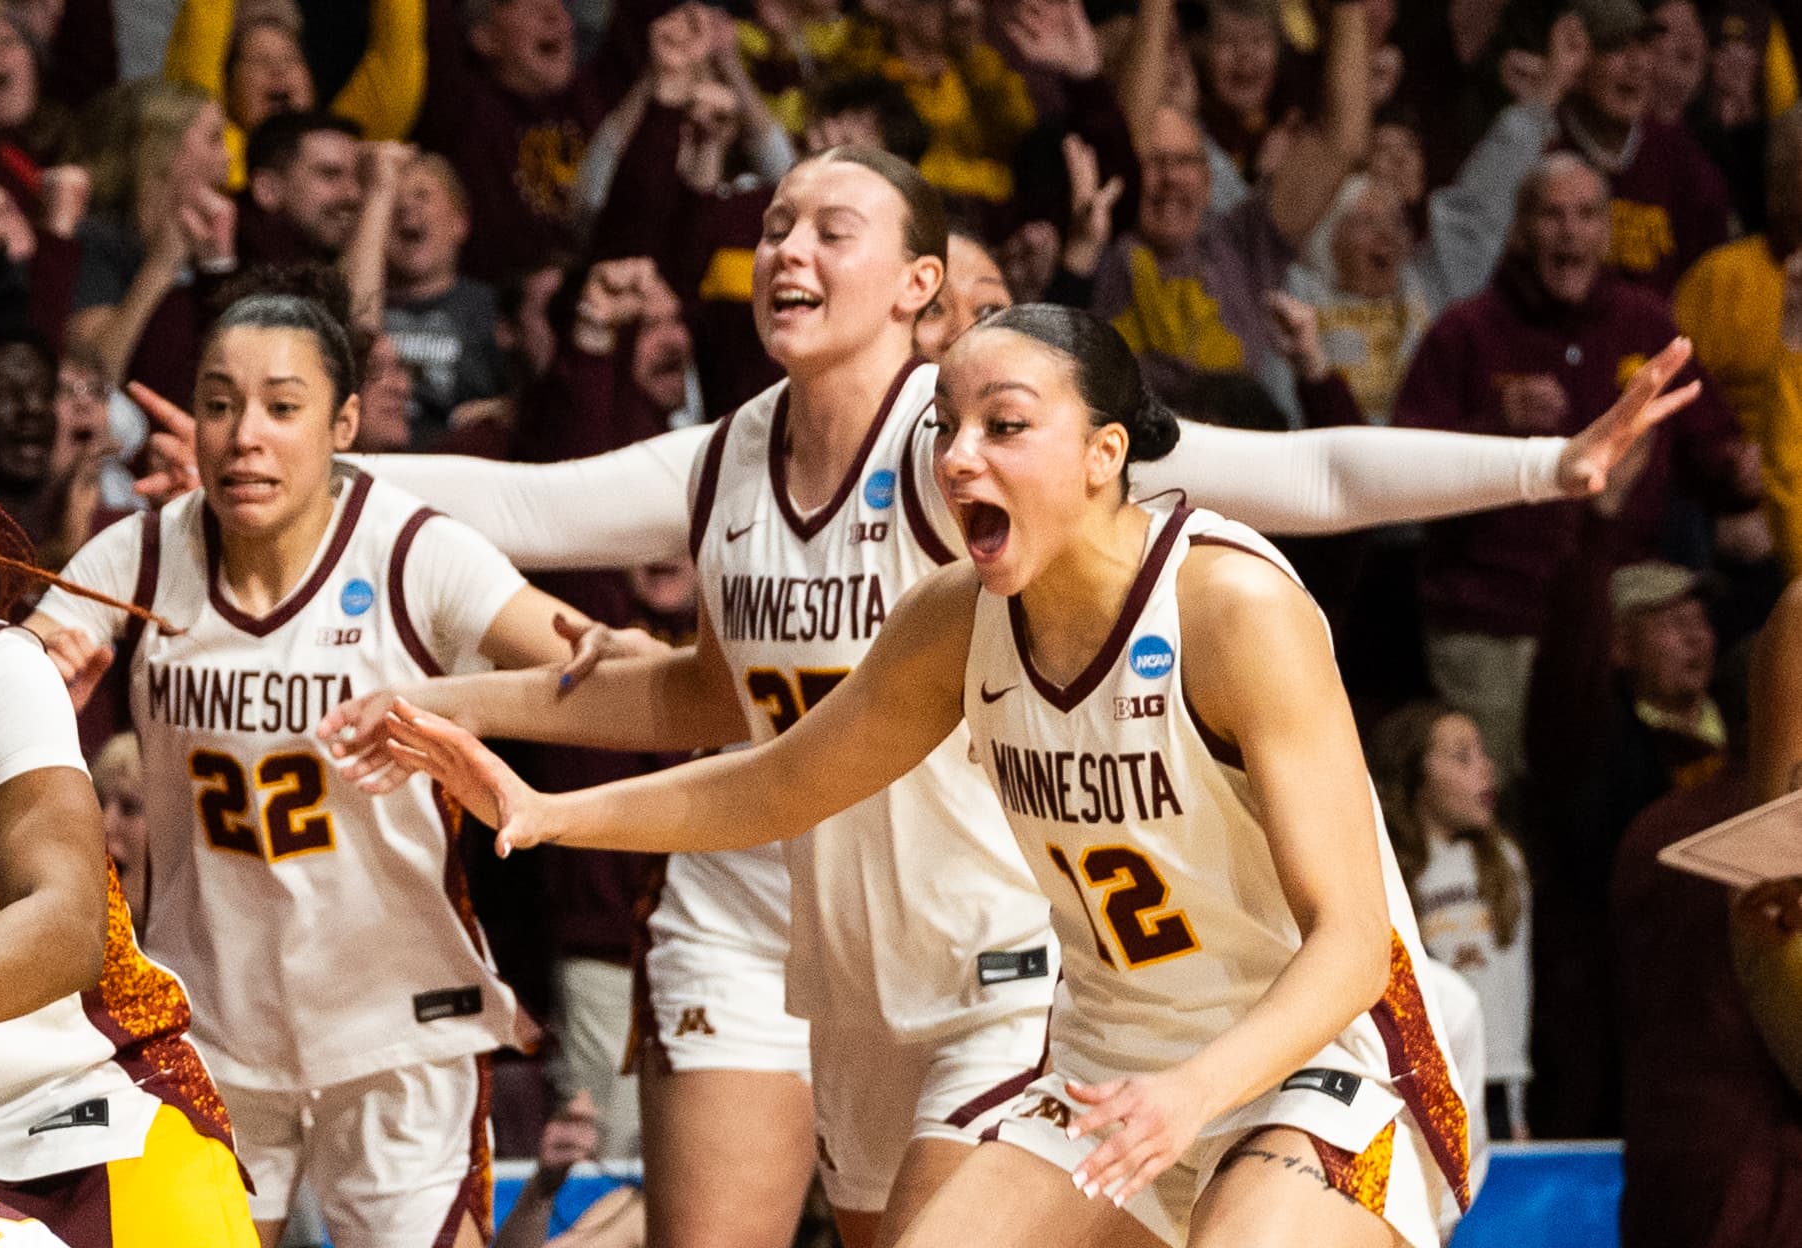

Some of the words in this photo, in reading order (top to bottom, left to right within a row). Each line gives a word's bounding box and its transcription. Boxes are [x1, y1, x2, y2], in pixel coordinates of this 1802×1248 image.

[722, 574, 886, 641] MINNESOTA
[1136, 653, 1173, 669] NCAA
[187, 747, 337, 865] 22
[991, 739, 1183, 824] MINNESOTA
[1046, 842, 1202, 972] 12
